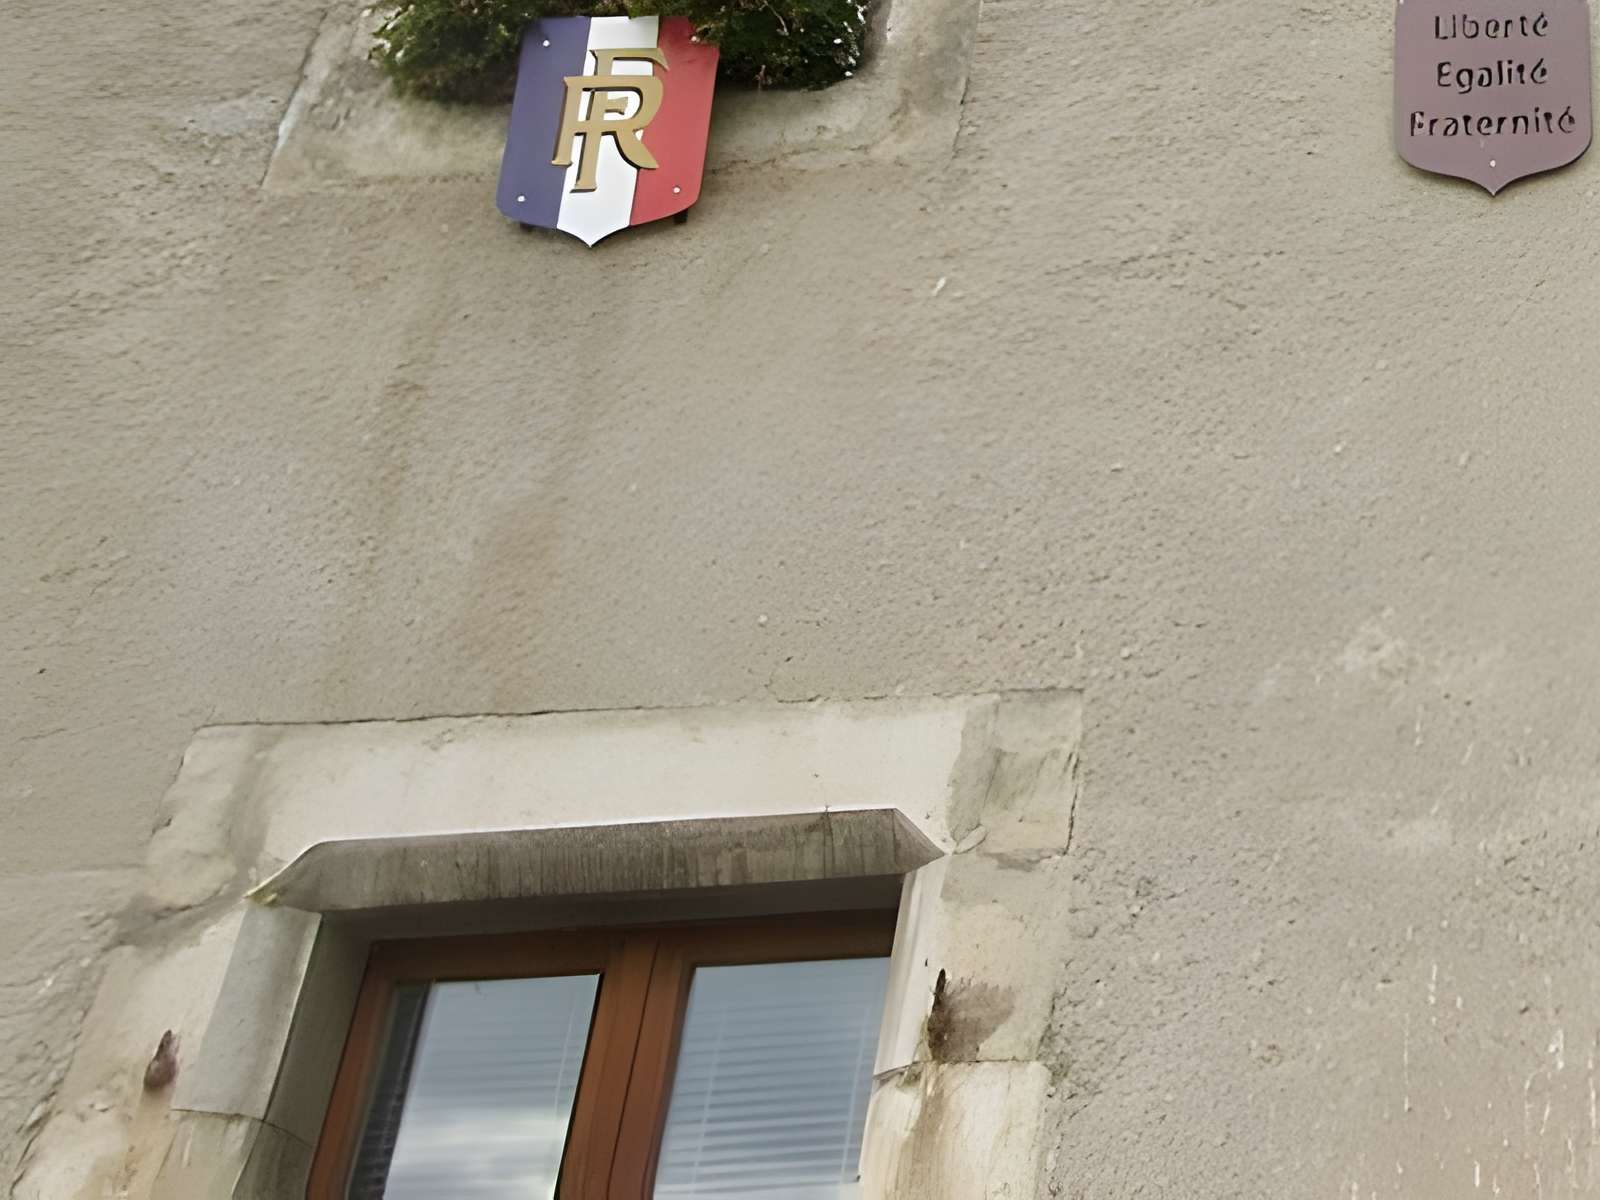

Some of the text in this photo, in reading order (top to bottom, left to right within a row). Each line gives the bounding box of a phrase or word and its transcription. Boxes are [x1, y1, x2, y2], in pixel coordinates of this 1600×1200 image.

[1434, 11, 1549, 40] Liberté
[1436, 58, 1548, 94] Egalité
[1410, 106, 1576, 137] Fraternité
